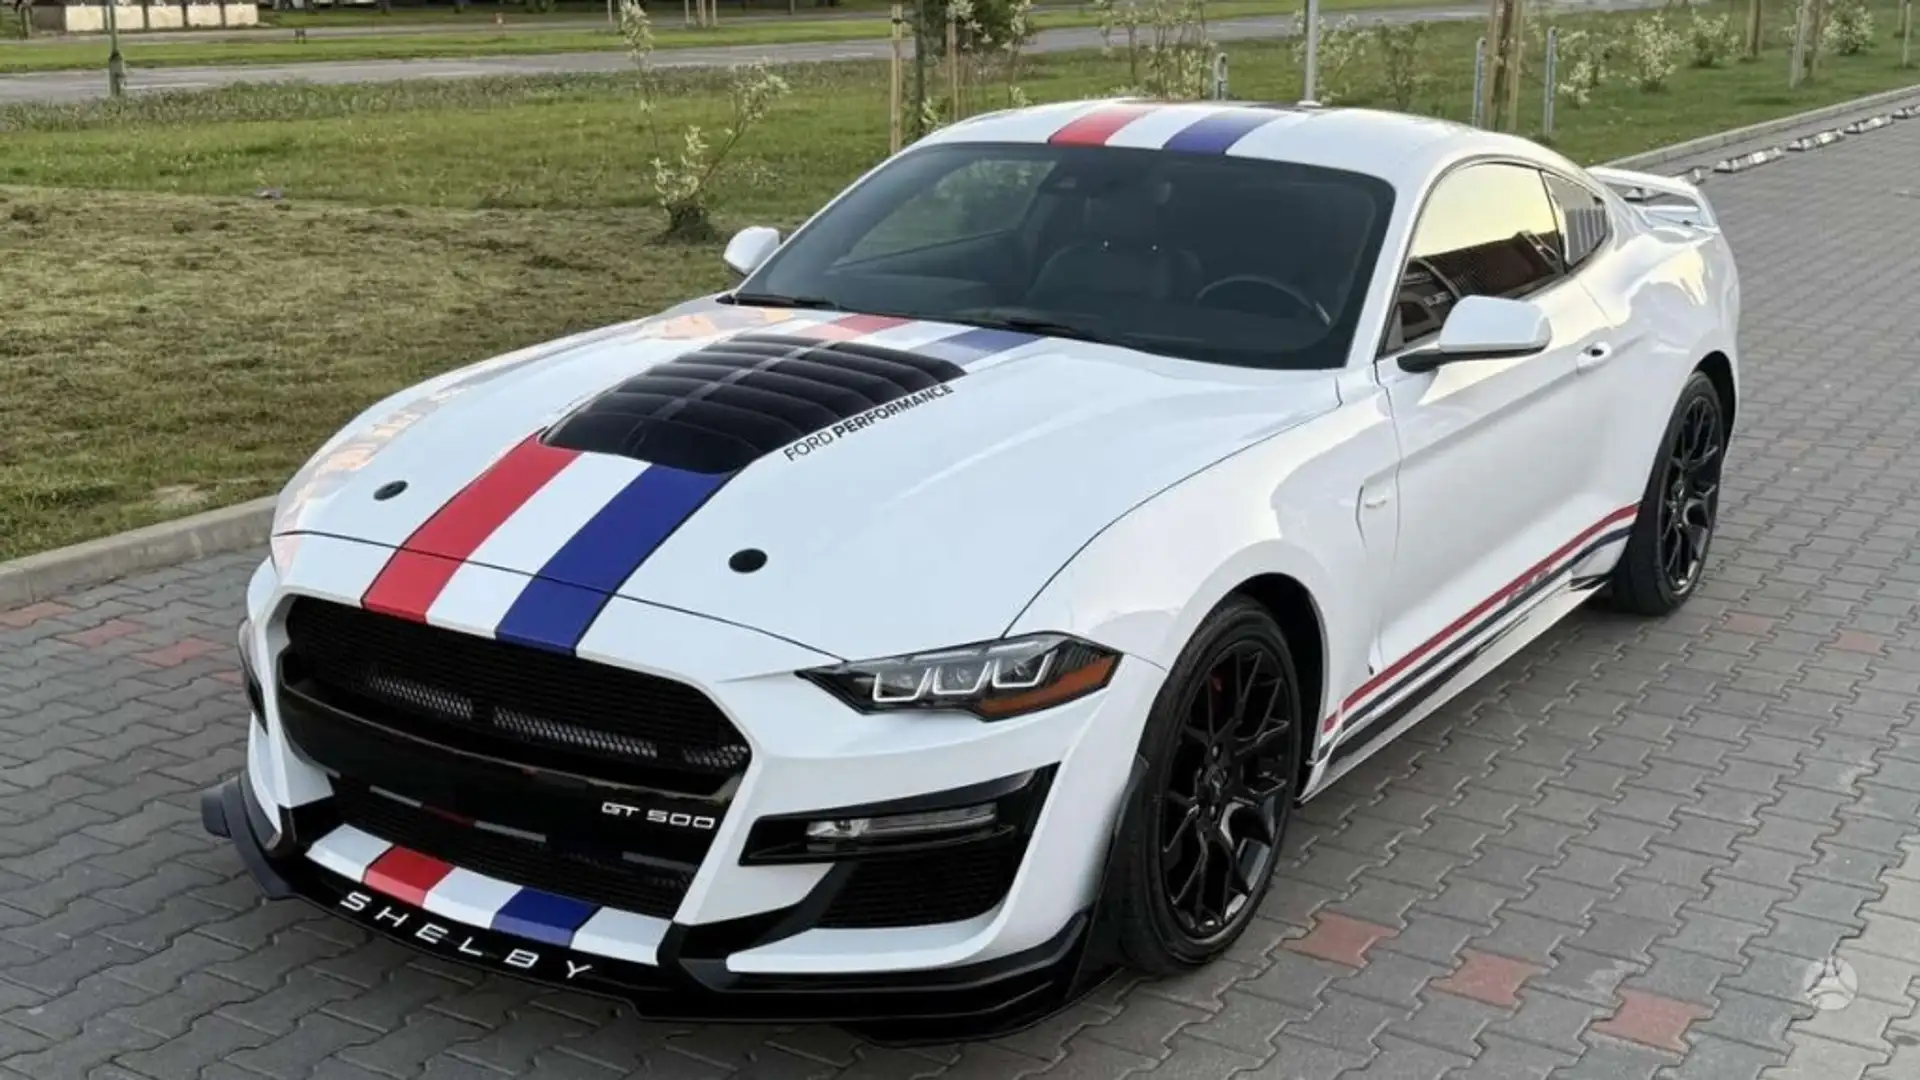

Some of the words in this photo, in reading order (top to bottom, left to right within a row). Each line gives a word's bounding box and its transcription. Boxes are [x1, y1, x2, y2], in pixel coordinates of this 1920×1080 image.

[783, 430, 834, 462] FORD
[832, 384, 954, 438] PERFORMANCE
[601, 801, 640, 817] GT
[646, 809, 716, 829] 500
[340, 891, 592, 979] SHELBY
